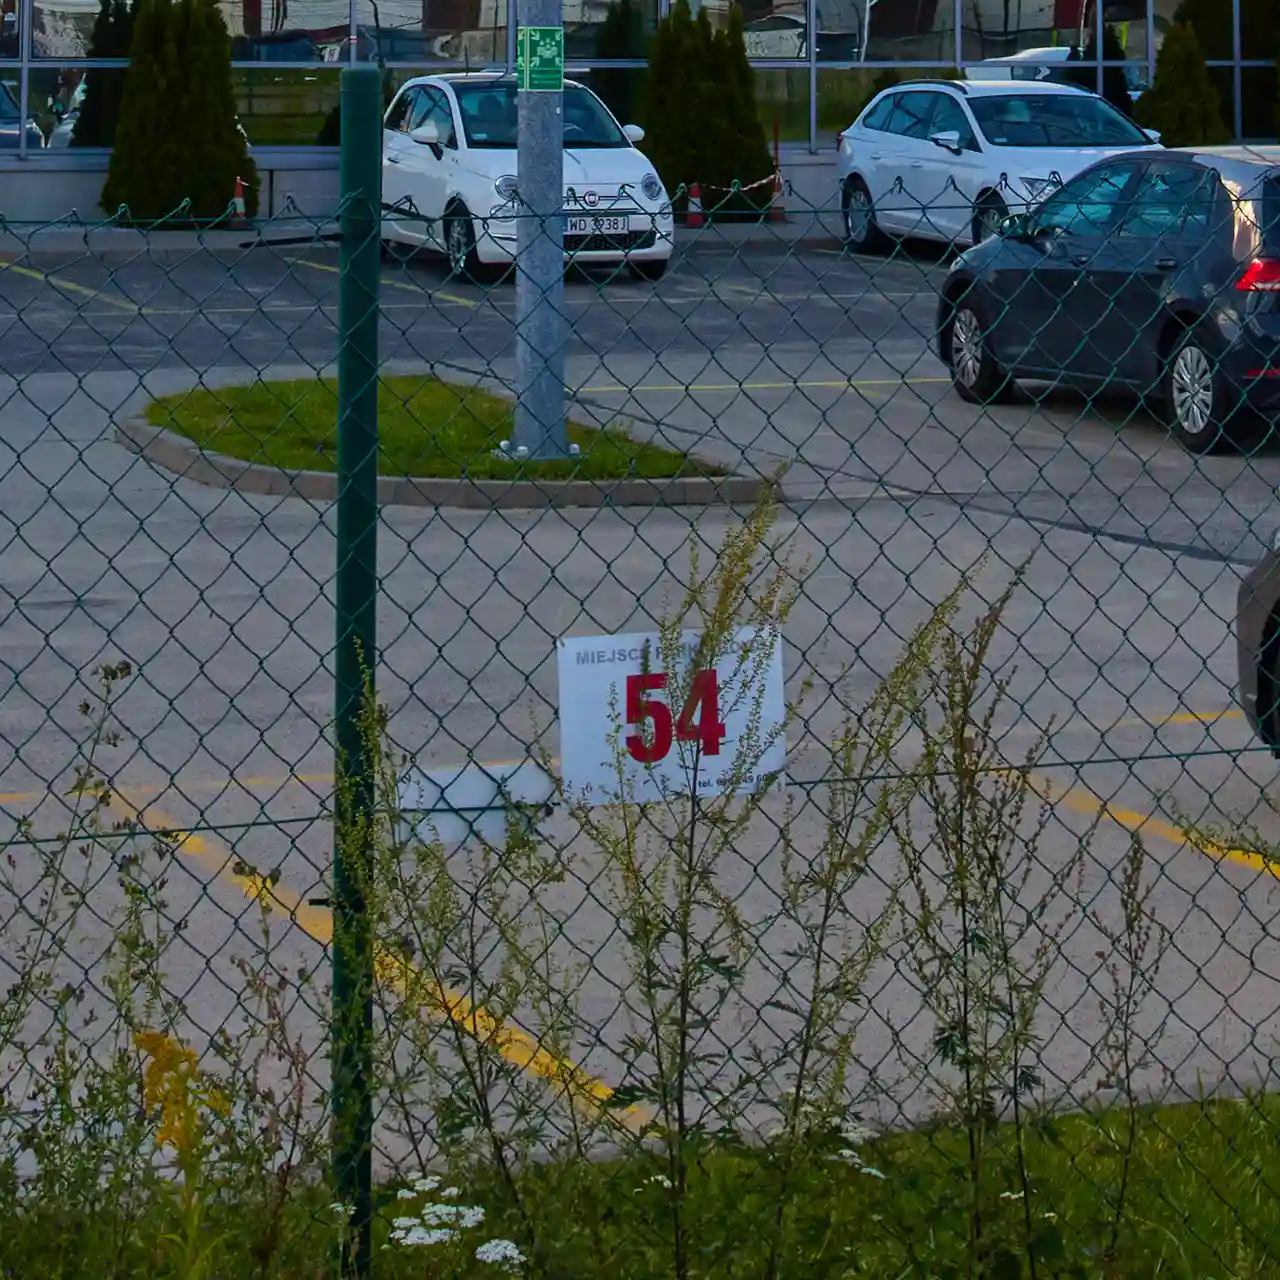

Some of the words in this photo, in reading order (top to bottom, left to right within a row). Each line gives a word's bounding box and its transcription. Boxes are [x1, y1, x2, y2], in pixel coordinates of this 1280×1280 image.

[569, 218, 587, 231] WD
[576, 647, 650, 665] MIEJSC
[625, 668, 727, 763] 54
